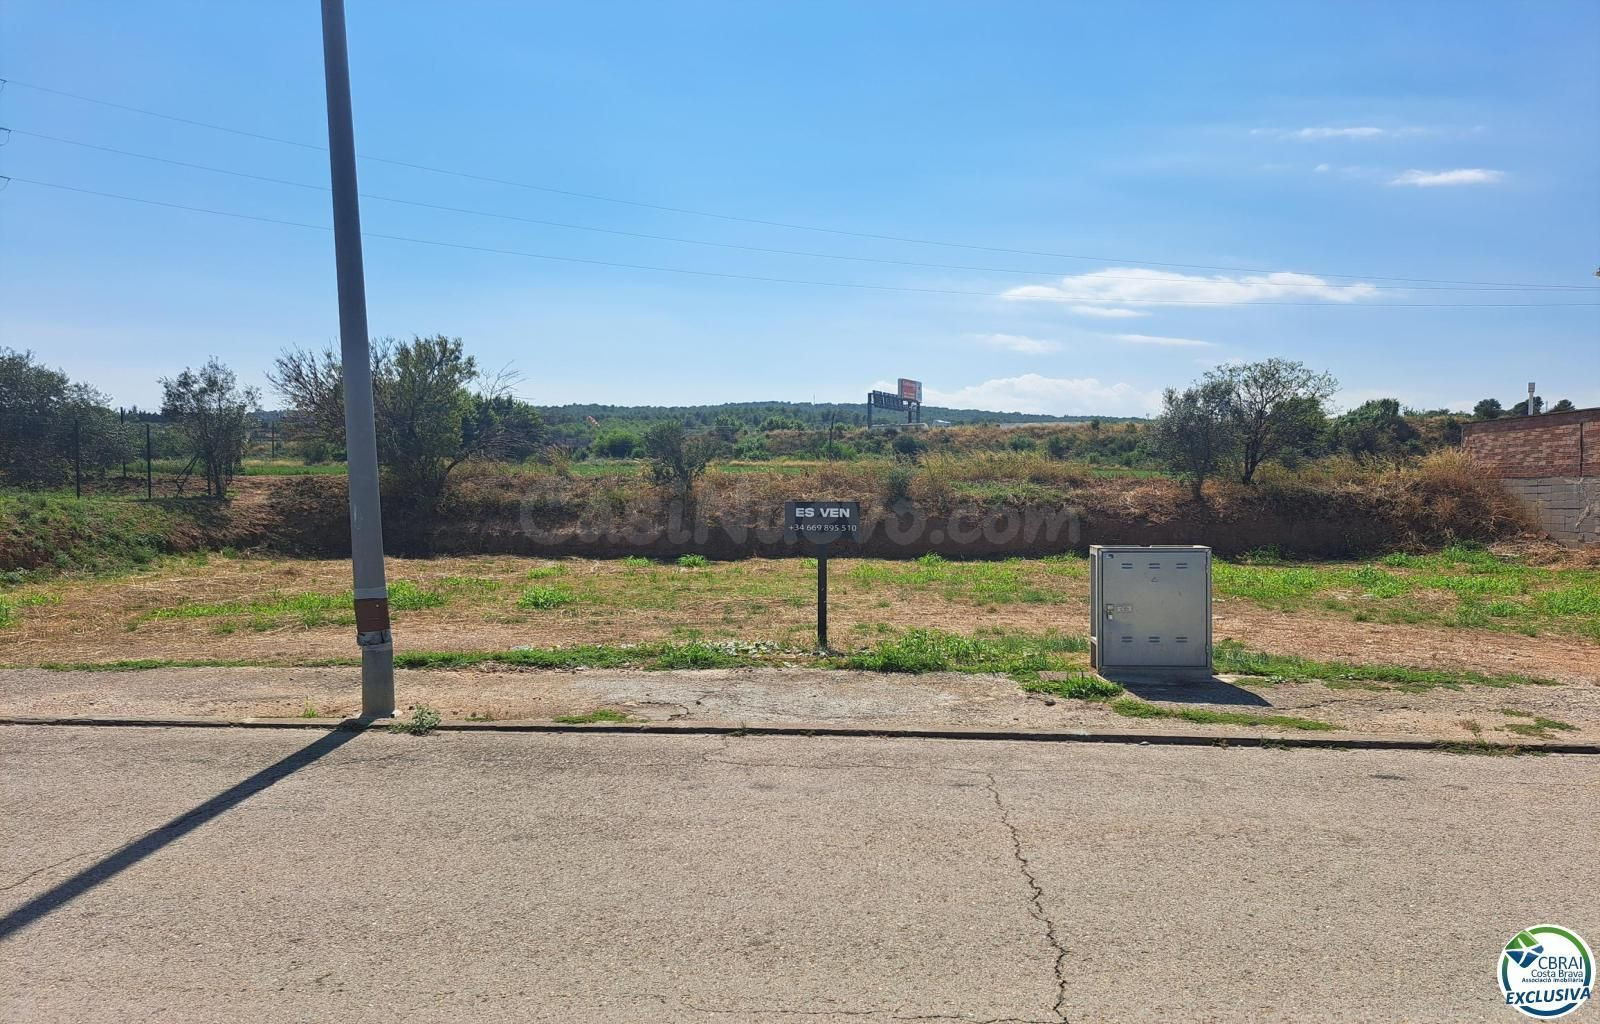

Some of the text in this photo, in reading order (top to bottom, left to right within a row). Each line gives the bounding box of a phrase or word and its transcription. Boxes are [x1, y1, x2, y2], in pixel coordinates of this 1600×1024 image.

[795, 507, 850, 518] ES VEN
[788, 523, 804, 531] +34
[824, 524, 839, 532] 895
[841, 524, 857, 532] 510
